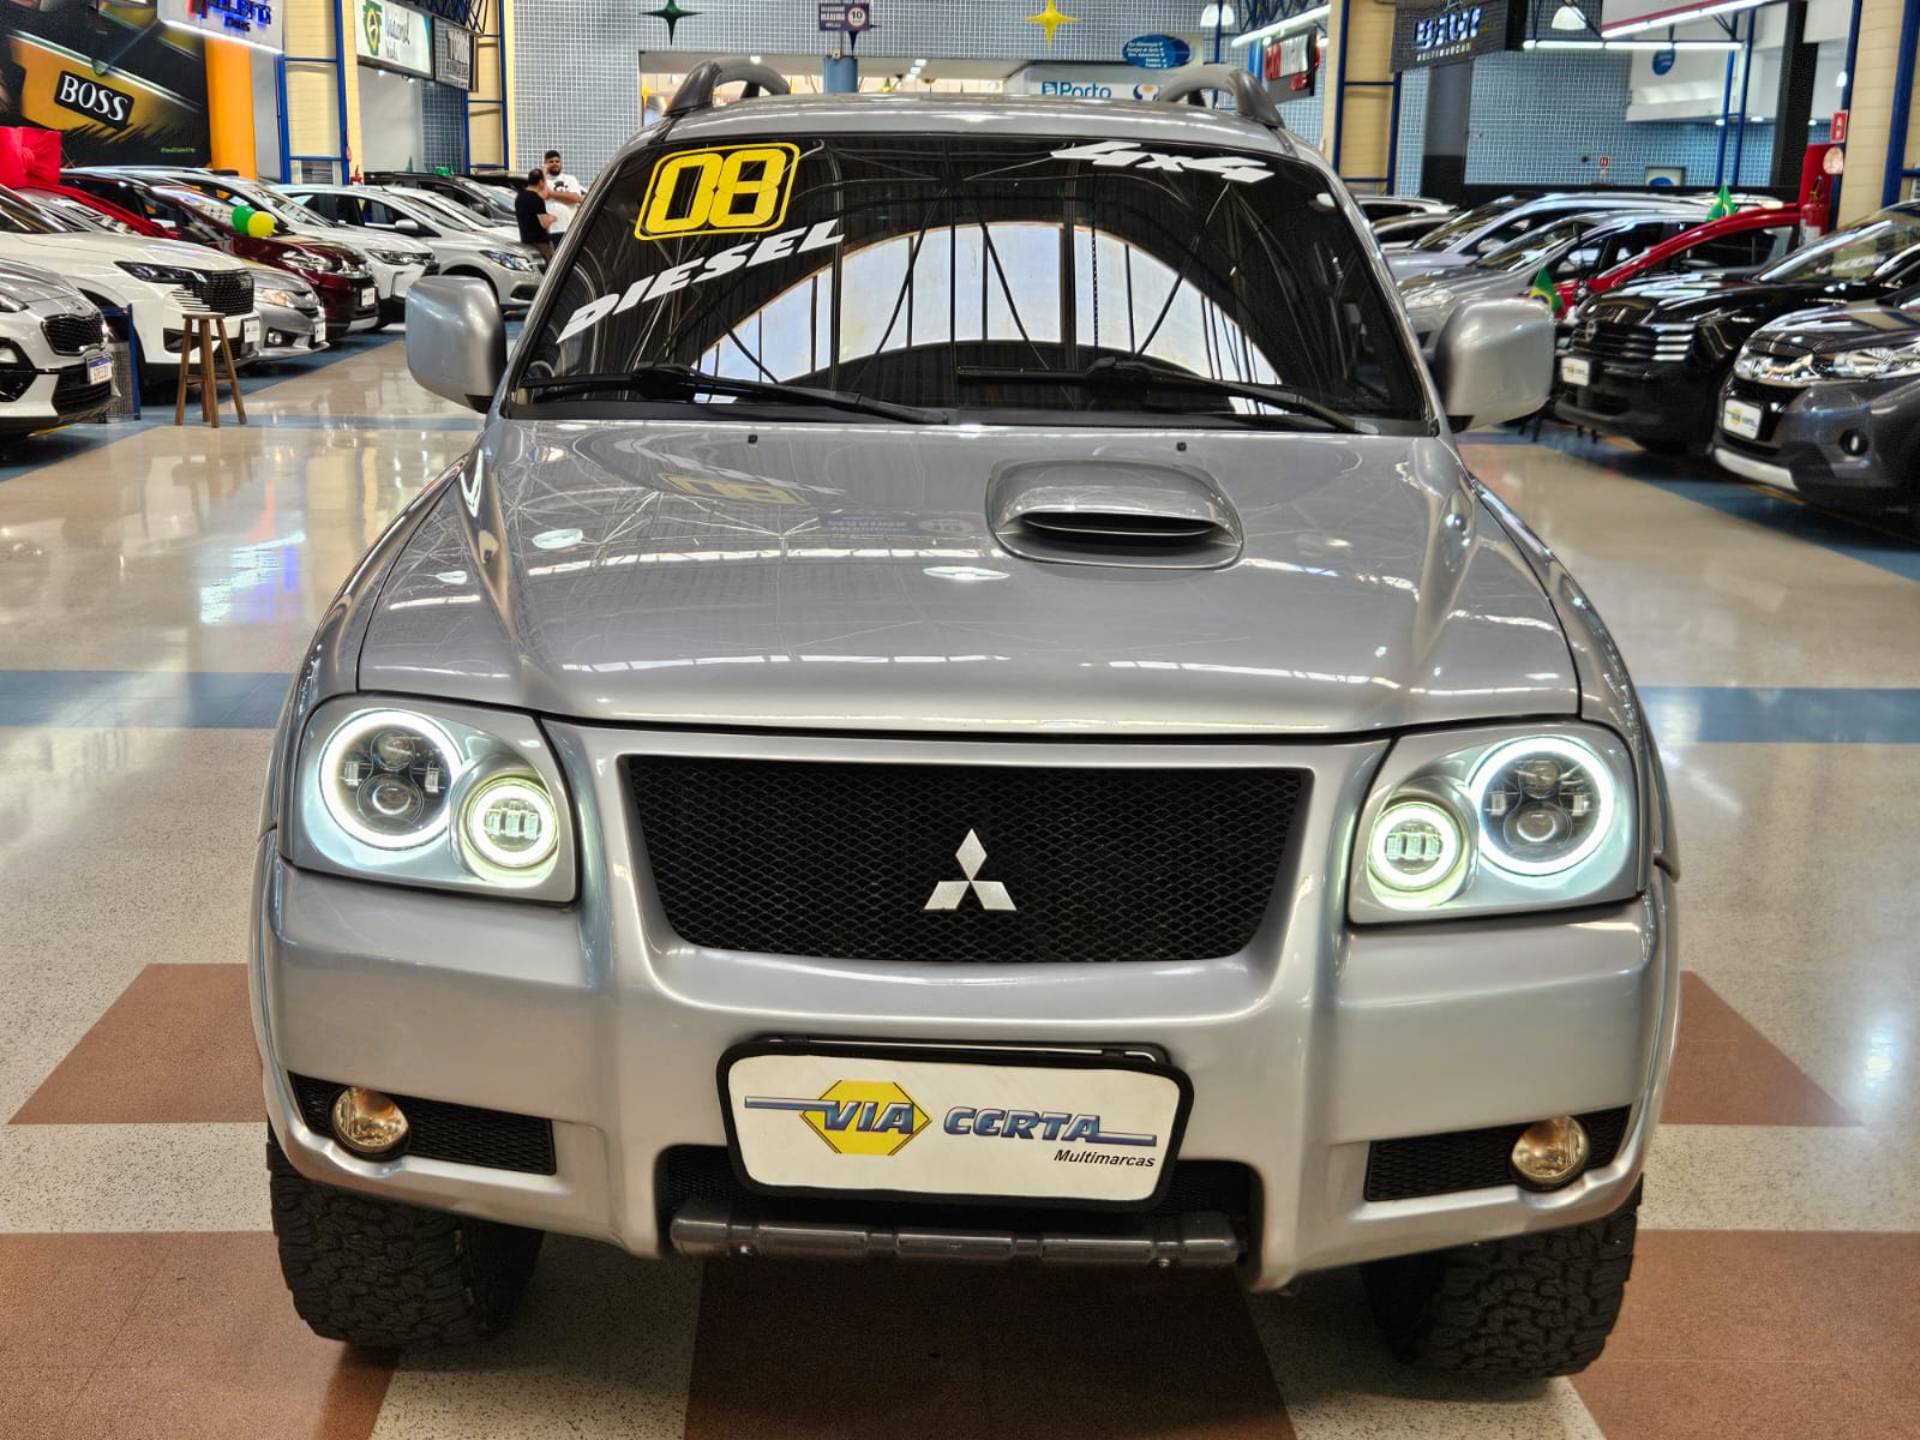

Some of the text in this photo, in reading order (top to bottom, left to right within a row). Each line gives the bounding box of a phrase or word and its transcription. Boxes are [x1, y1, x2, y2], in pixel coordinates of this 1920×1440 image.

[59, 74, 129, 121] BOSS
[1060, 80, 1112, 99] Porto
[645, 147, 787, 234] 08
[556, 218, 846, 345] DIESEL
[821, 1101, 1101, 1143] VIA CERTA
[1053, 1148, 1155, 1168] Multimarcas
